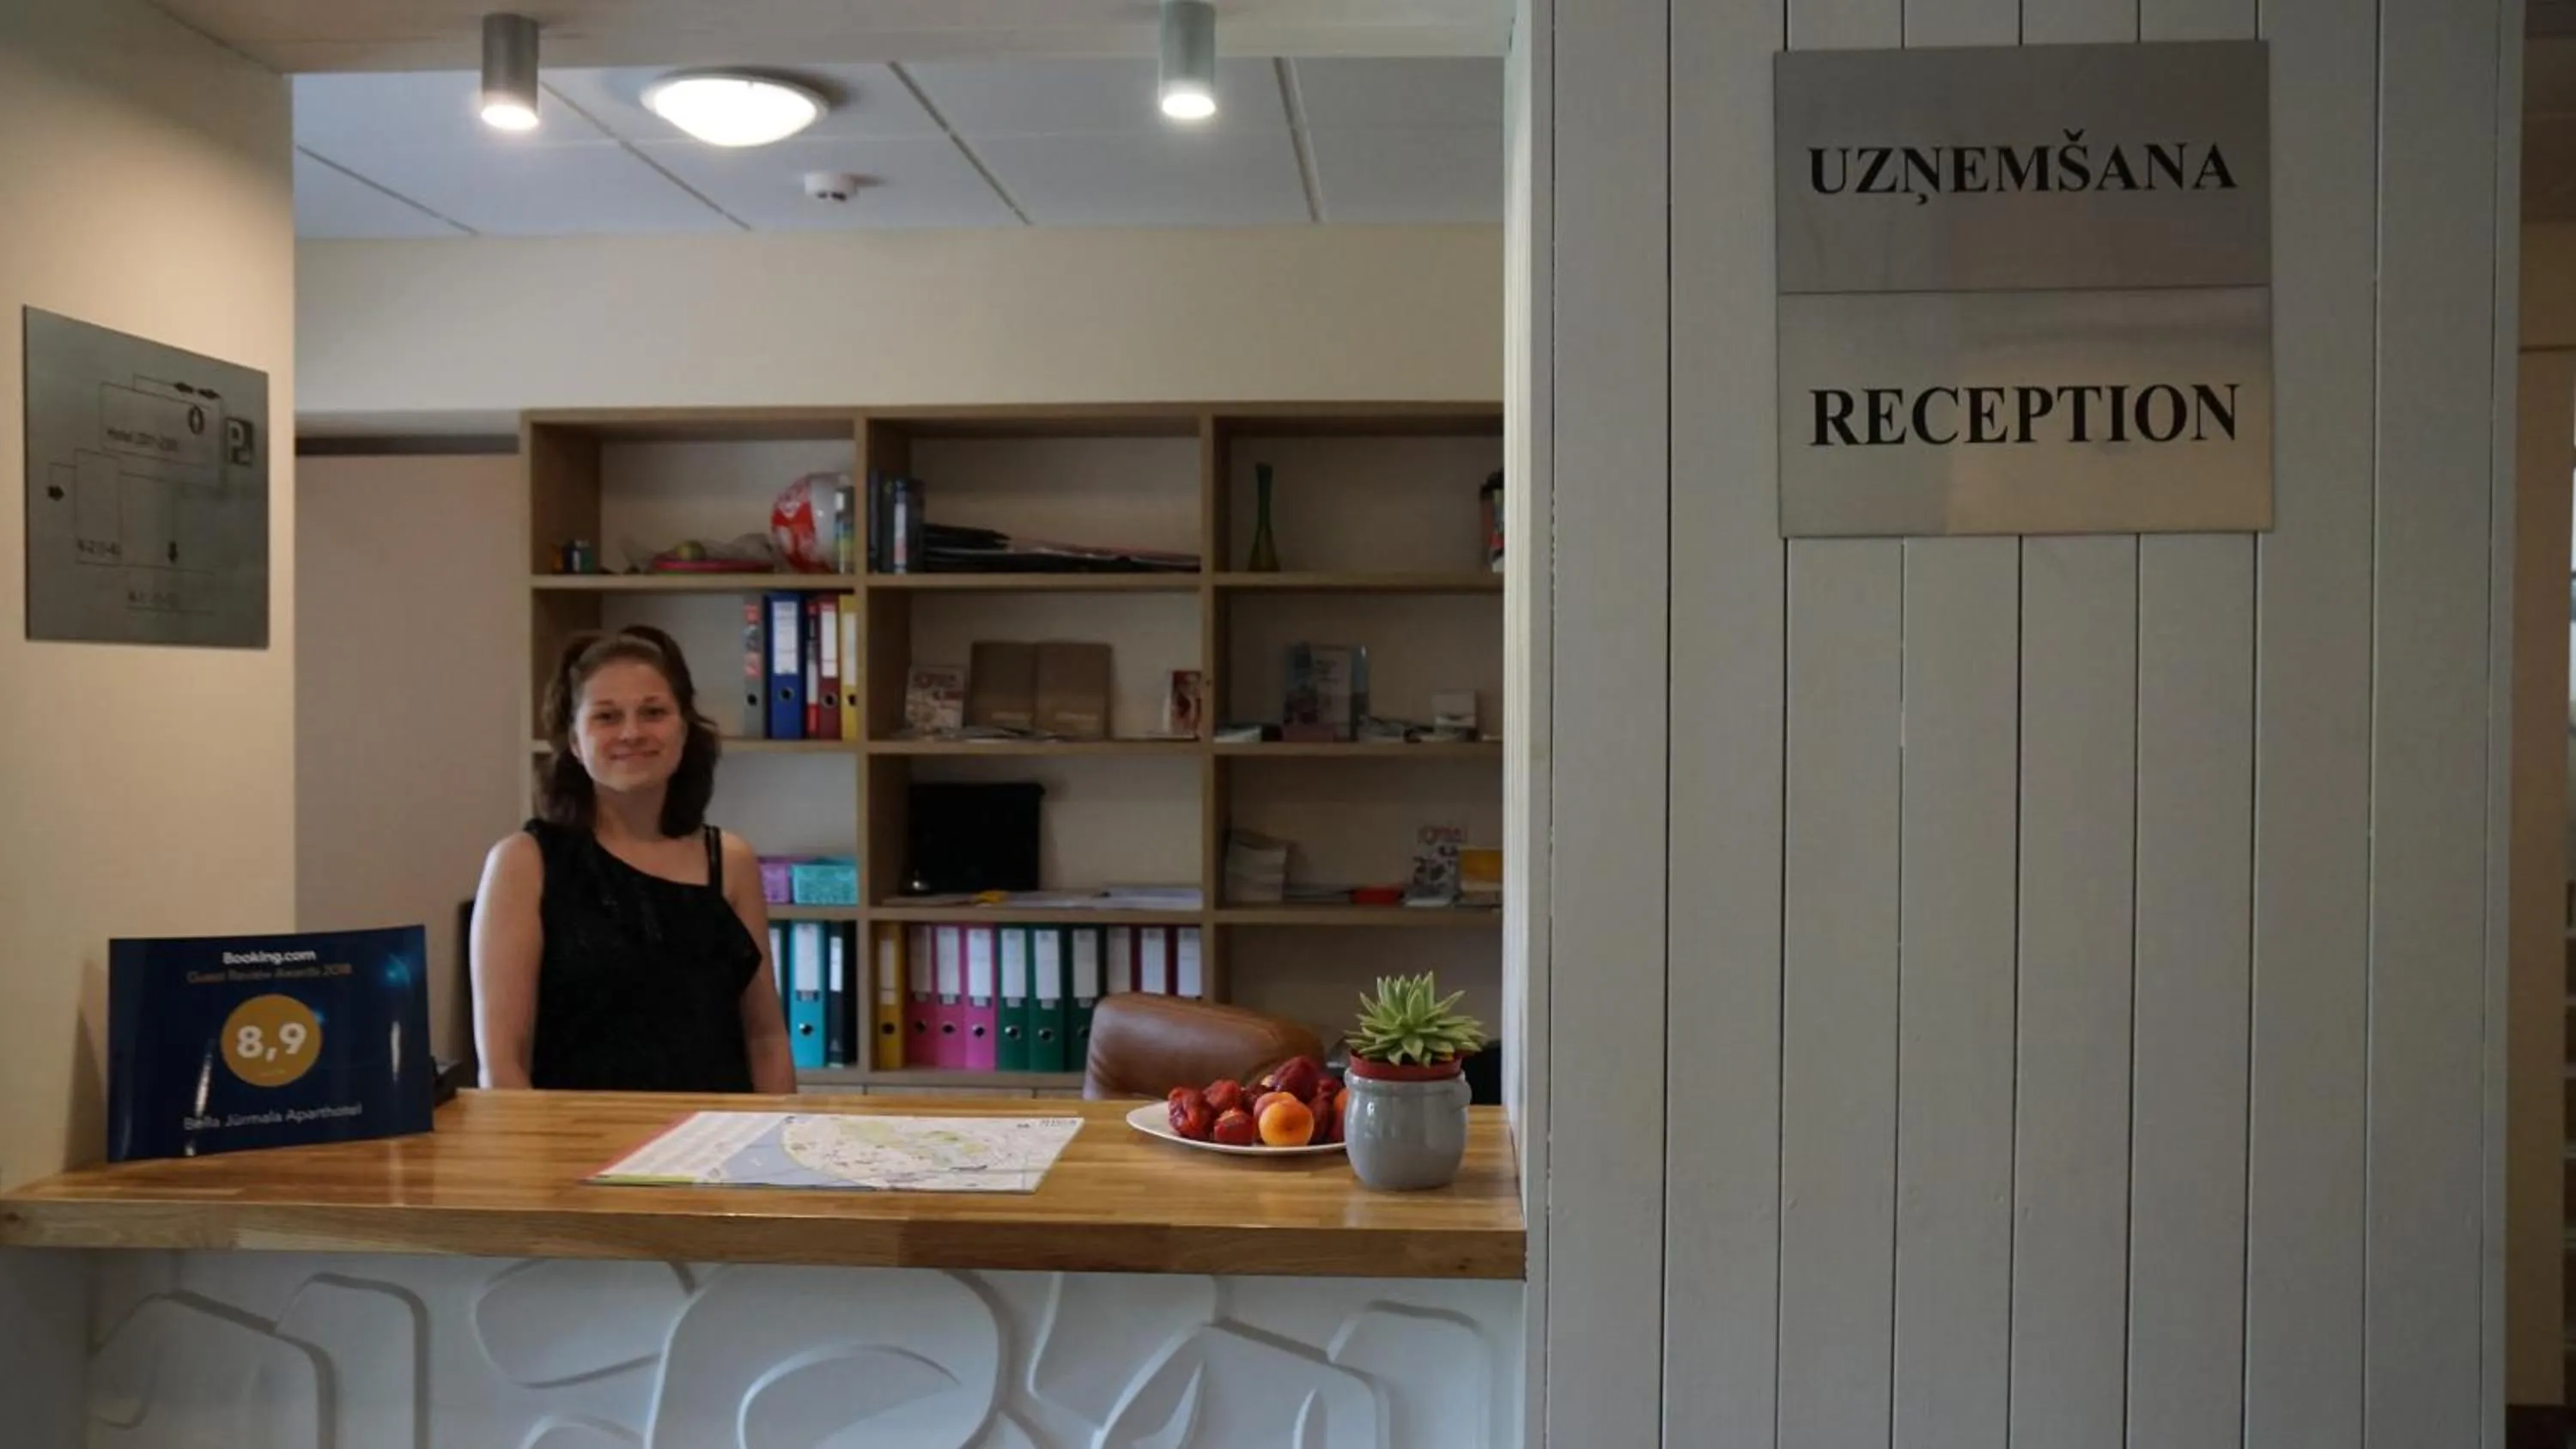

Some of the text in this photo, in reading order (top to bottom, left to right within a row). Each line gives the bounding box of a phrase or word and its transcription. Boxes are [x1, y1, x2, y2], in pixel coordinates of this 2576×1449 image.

[1808, 129, 2239, 205] UZŅEMŠANA
[1809, 384, 2240, 446] RECEPTION
[222, 949, 317, 966] Booking.com
[228, 968, 272, 981] Review
[275, 965, 321, 979] Awards
[236, 1022, 307, 1063] 8,9
